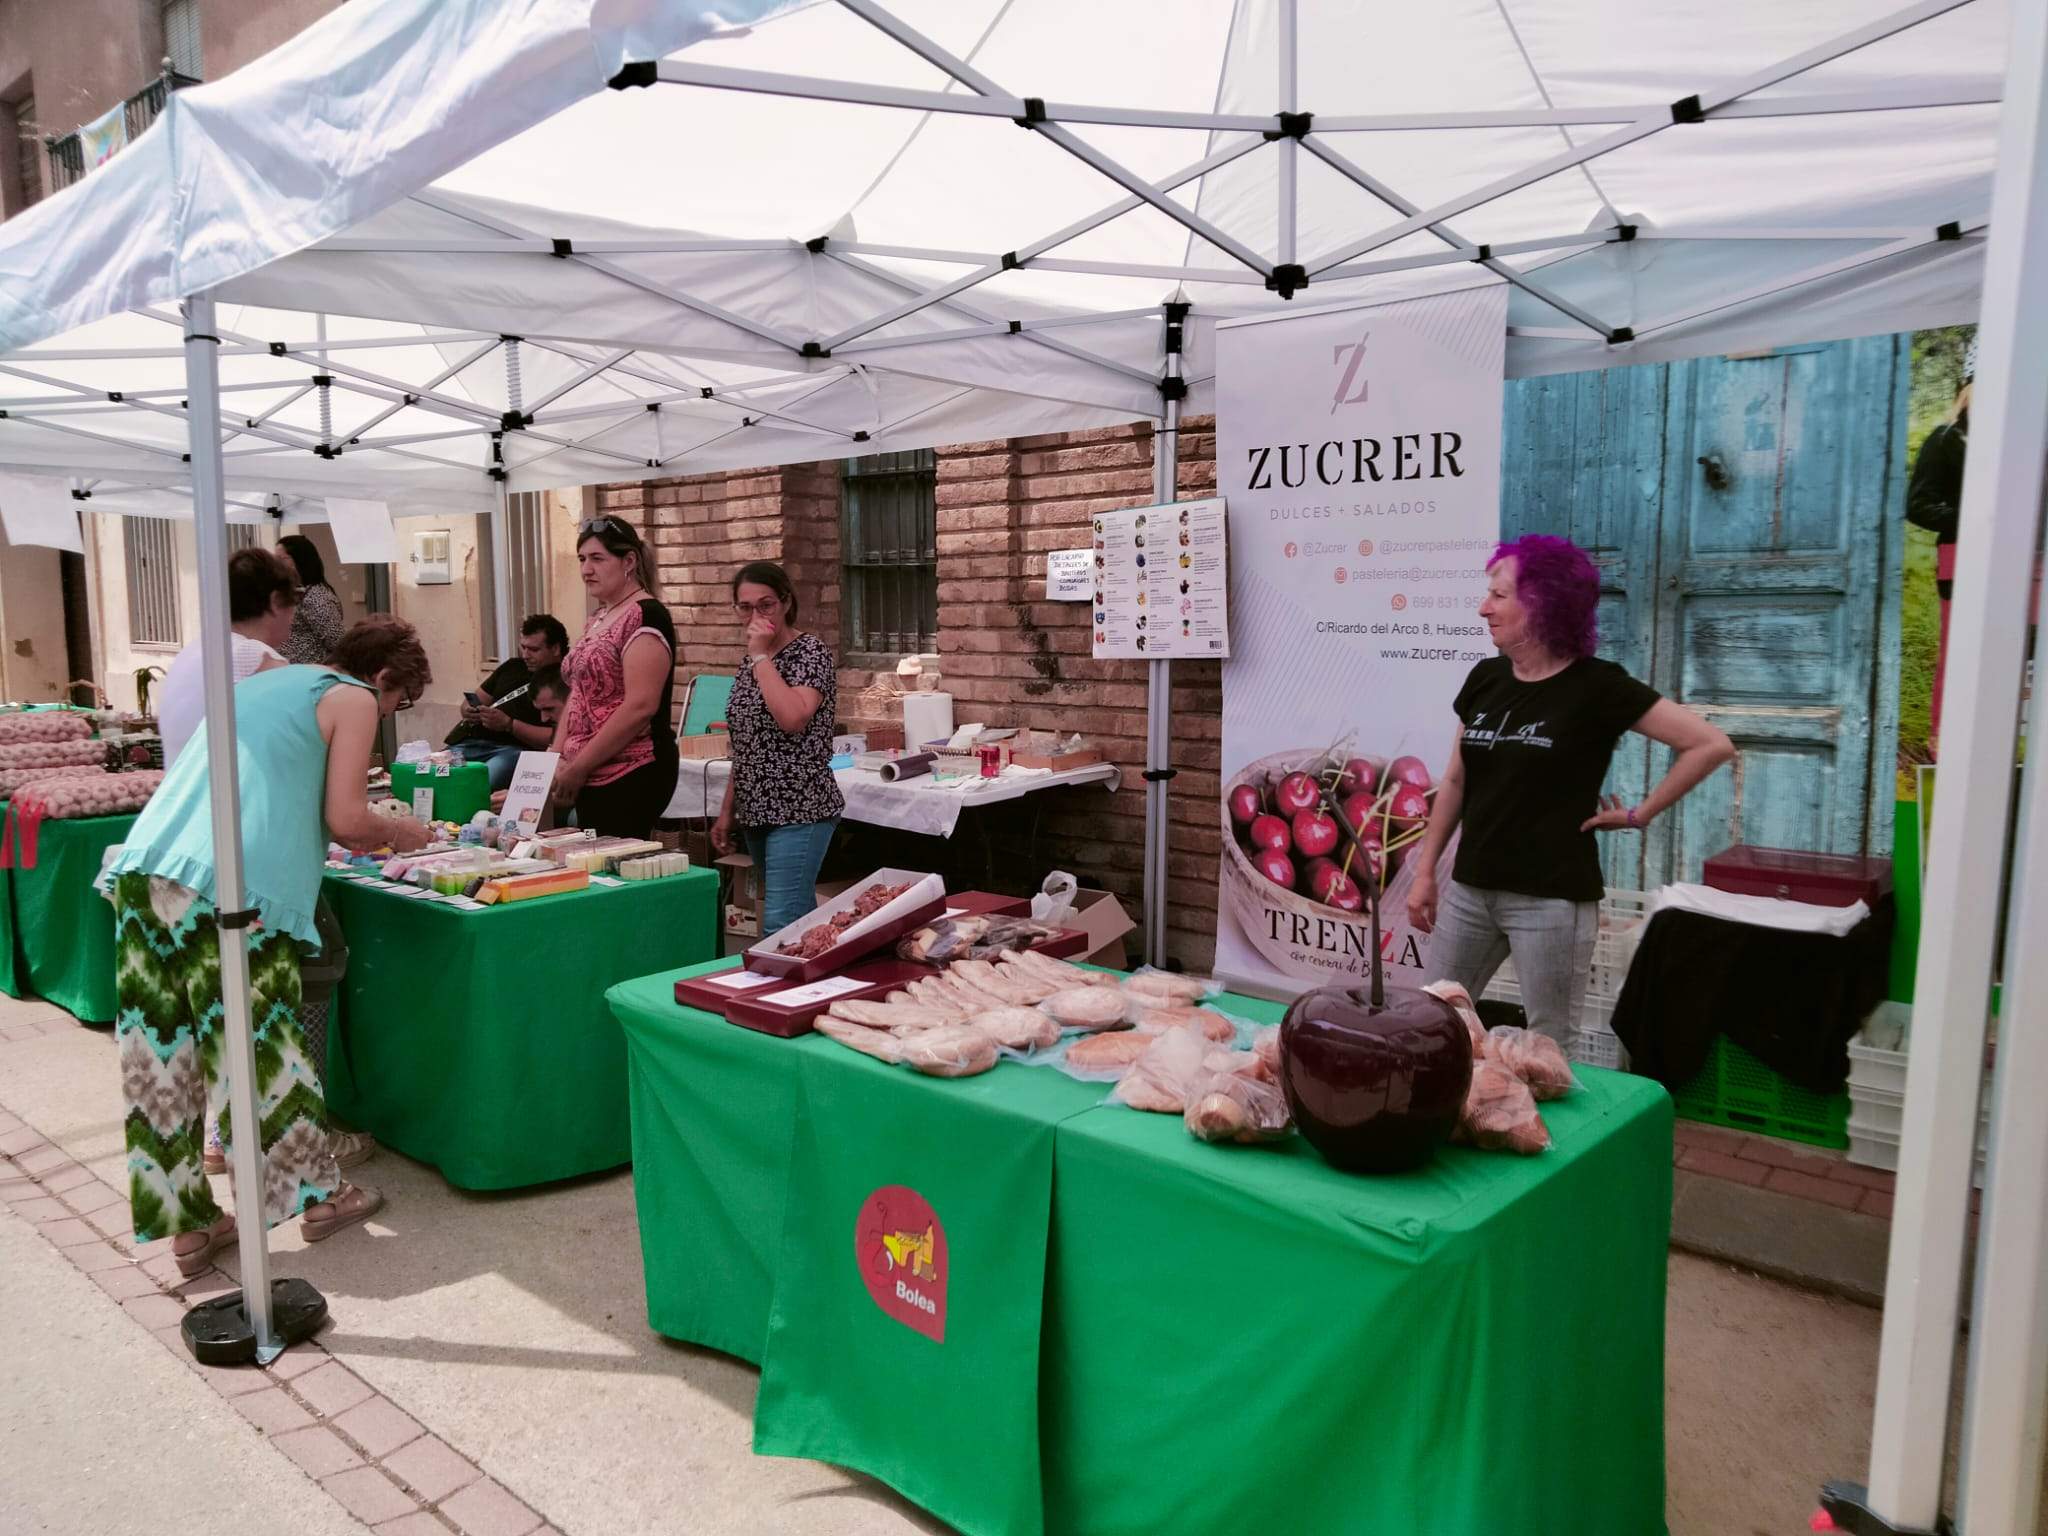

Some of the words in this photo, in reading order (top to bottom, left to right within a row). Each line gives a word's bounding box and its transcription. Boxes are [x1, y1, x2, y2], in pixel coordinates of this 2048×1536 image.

[1247, 431, 1465, 490] ZUCRER
[1270, 505, 1331, 521] DULCES
[1353, 500, 1437, 516] SALADOS
[1302, 542, 1348, 557] @Zucrer
[1412, 596, 1434, 608] 699
[1316, 621, 1368, 634] C/Ricardo
[1370, 623, 1389, 634] del
[1391, 623, 1419, 635] Arco
[1380, 648, 1487, 661] www.zucrer.com
[1264, 908, 1425, 970] TRENZA
[895, 1279, 936, 1315] Bolea
